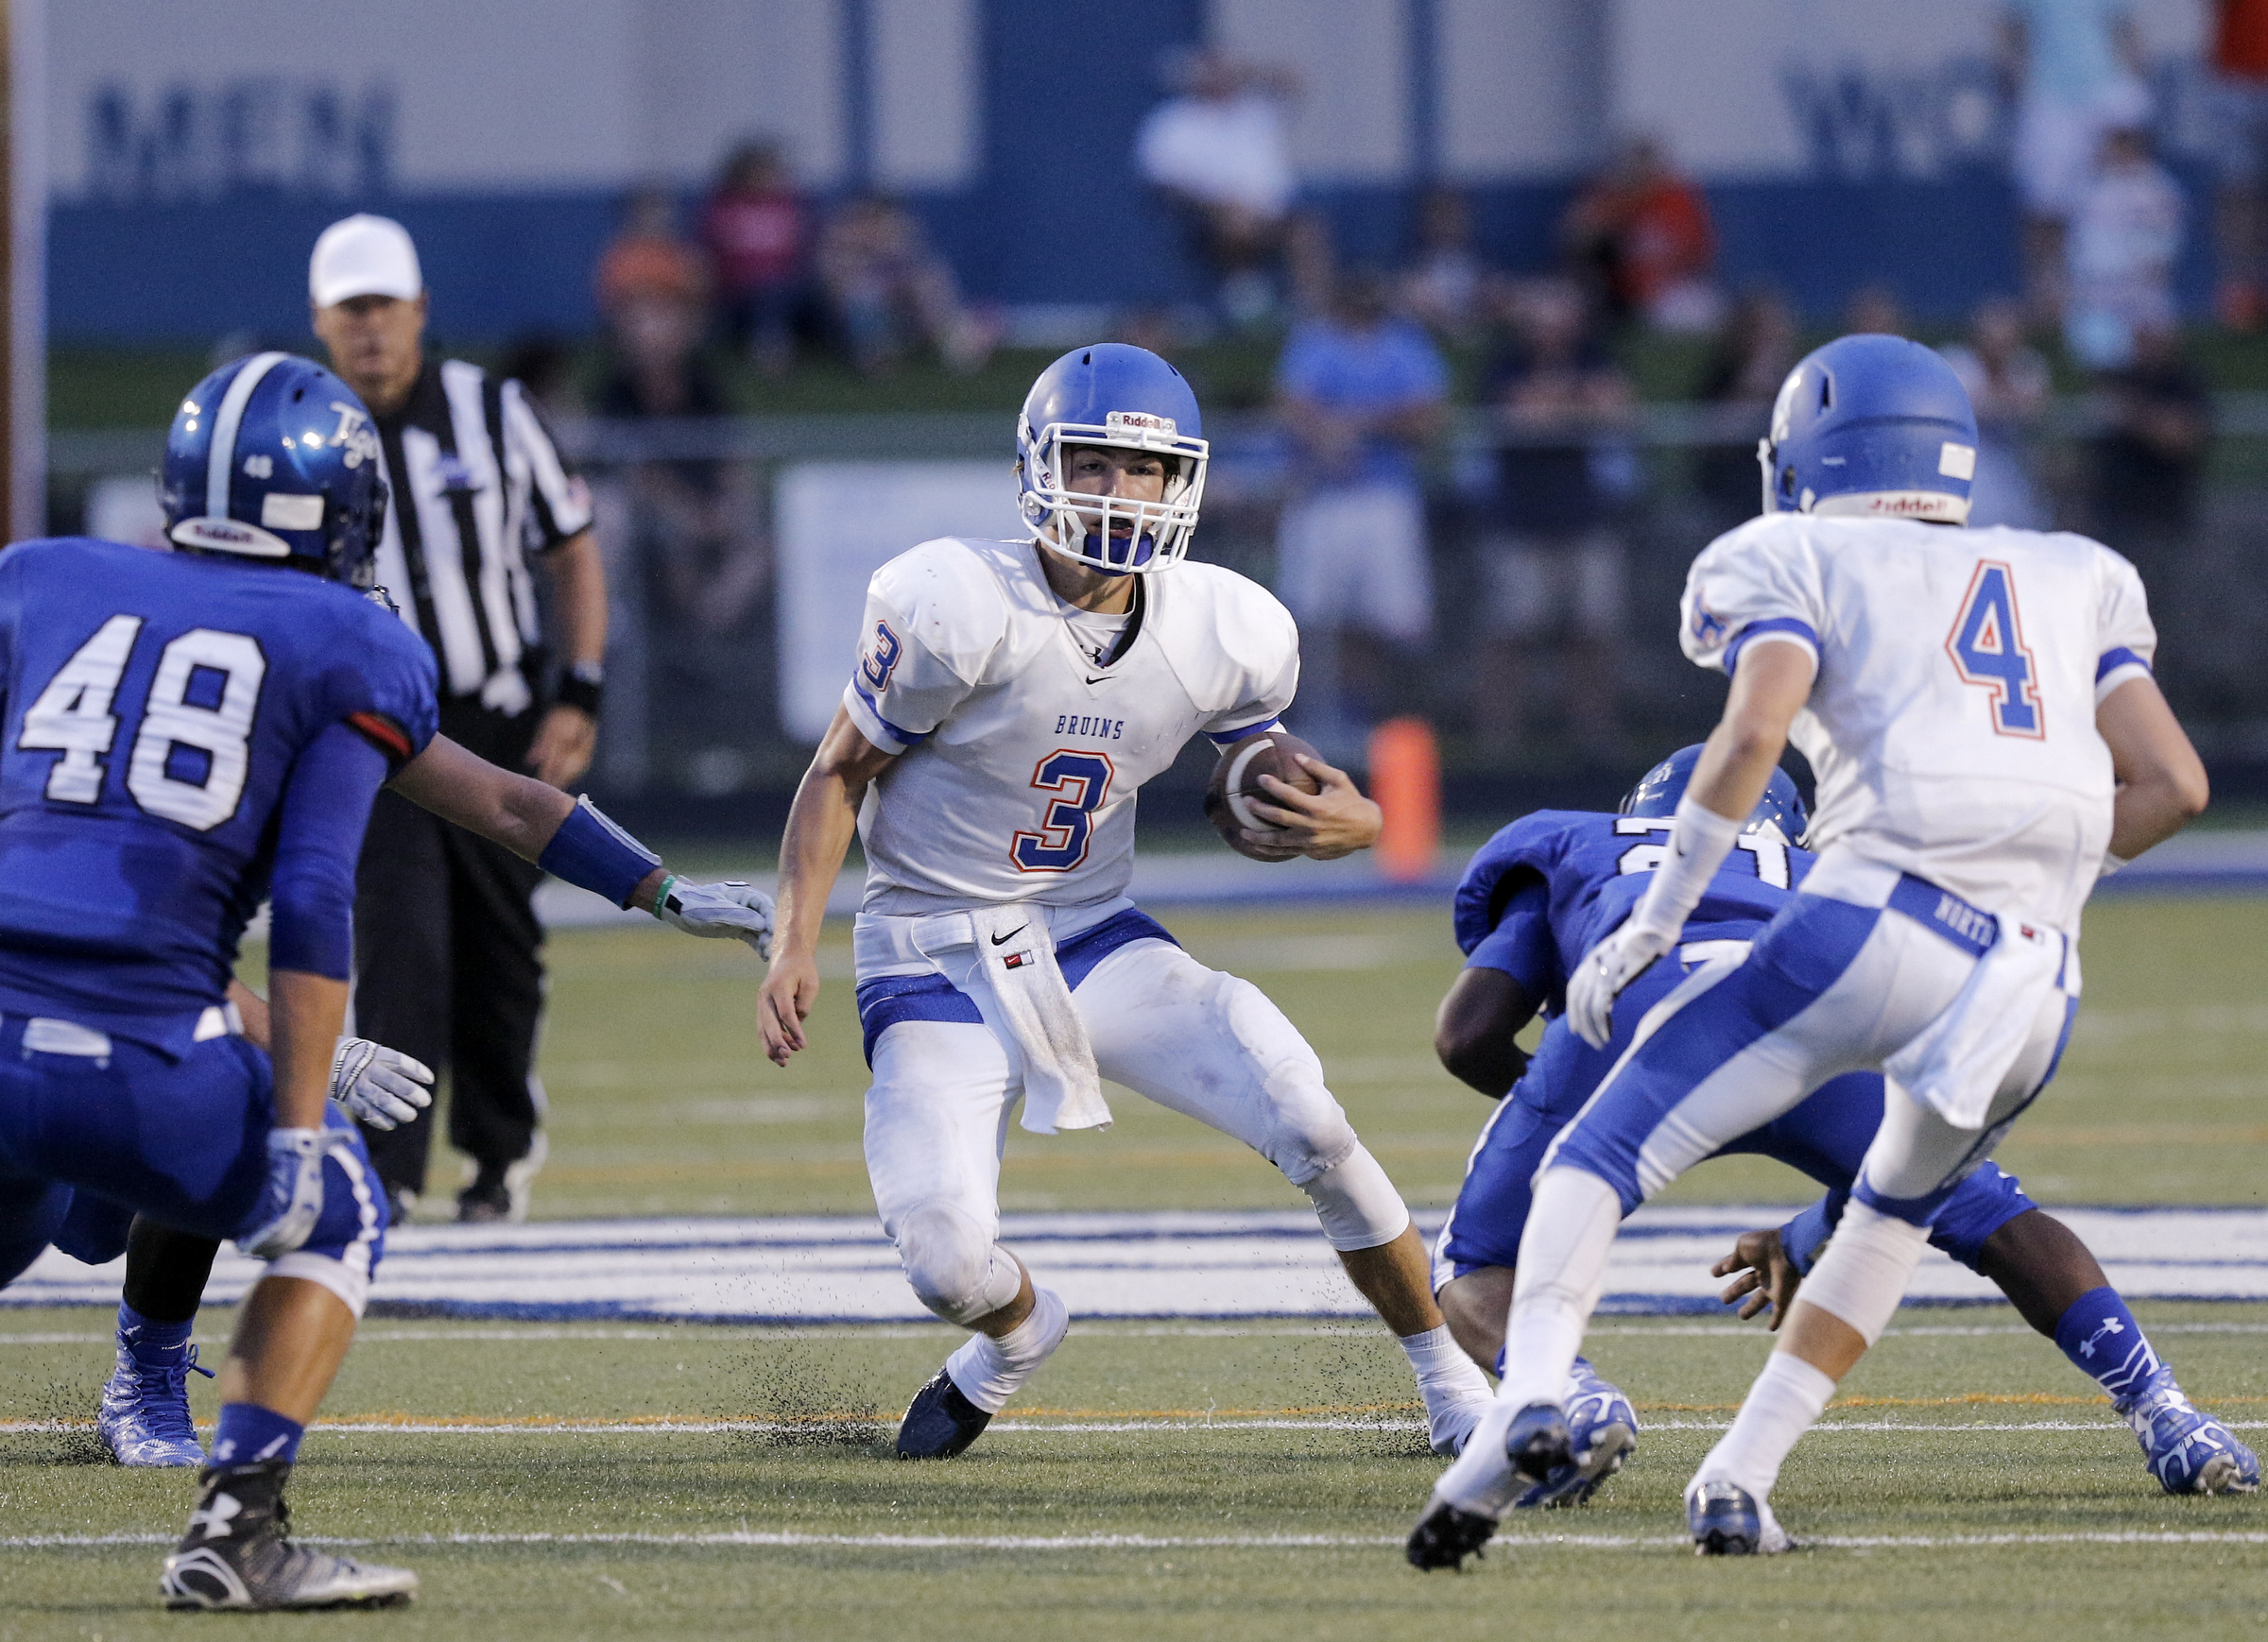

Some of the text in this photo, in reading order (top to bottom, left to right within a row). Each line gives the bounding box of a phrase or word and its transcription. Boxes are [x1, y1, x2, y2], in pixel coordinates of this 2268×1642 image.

[860, 619, 903, 693] 3
[1945, 558, 2046, 742] 4
[16, 612, 267, 832] 48
[1055, 714, 1125, 740] BRUINS
[1008, 748, 1115, 873] 3
